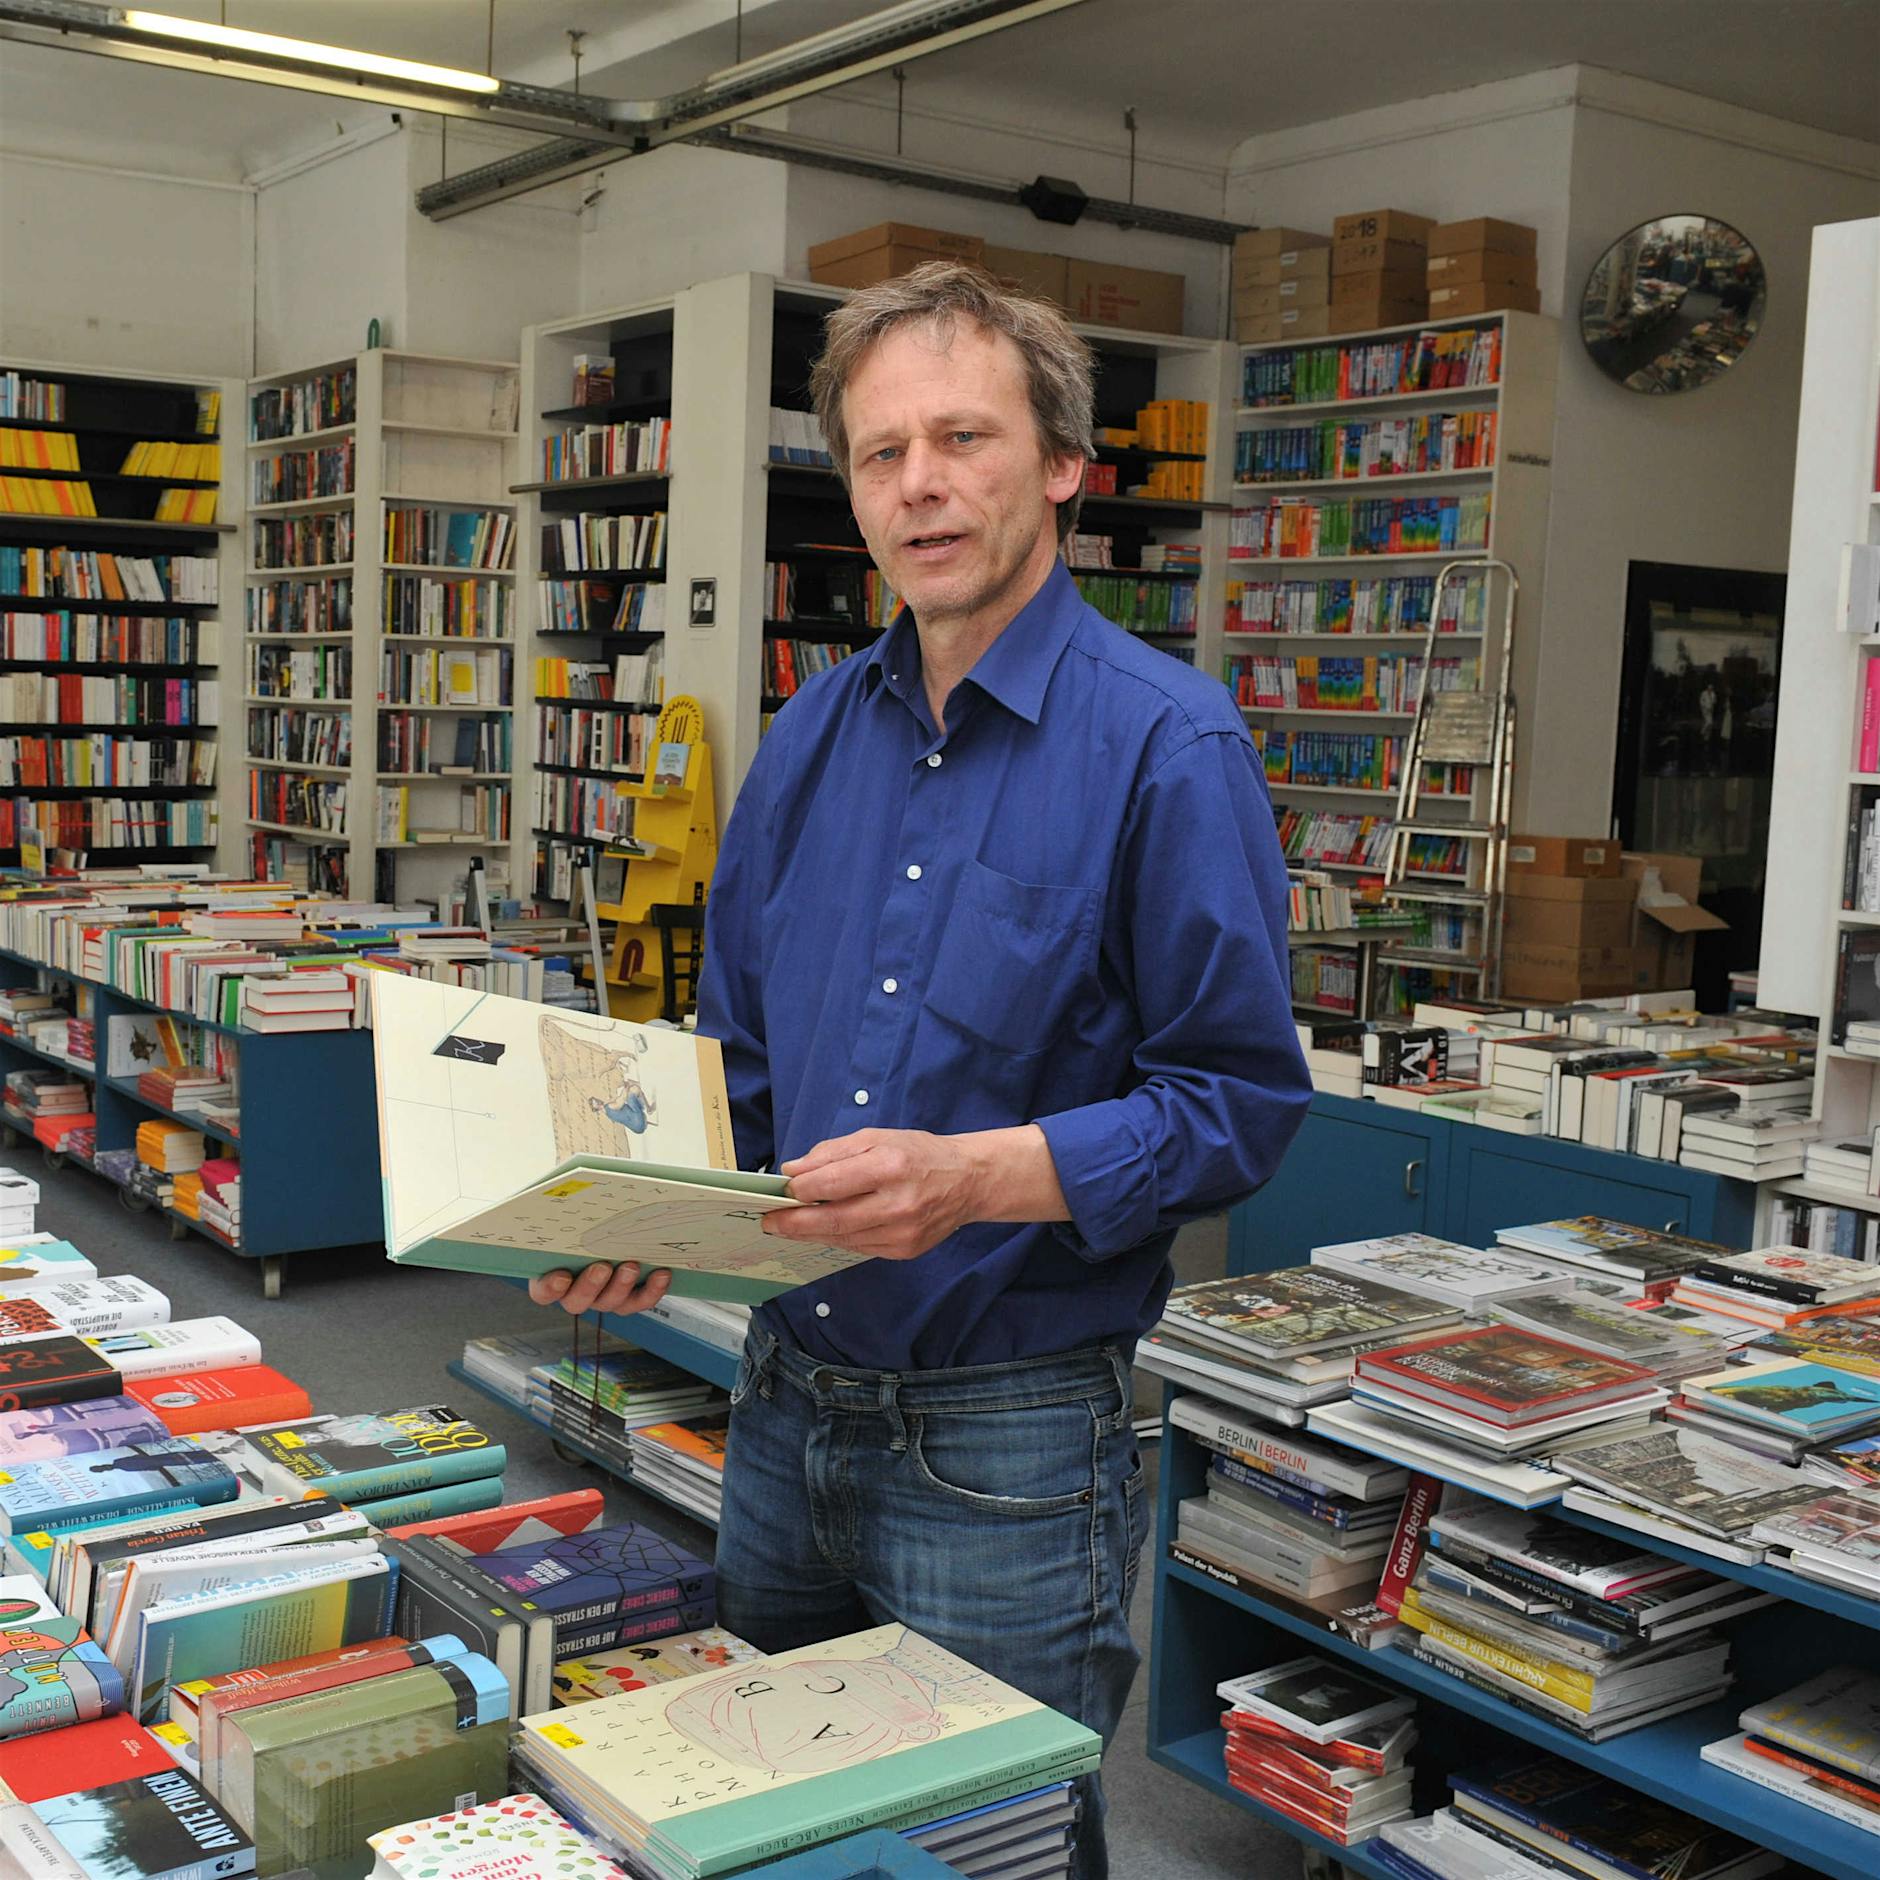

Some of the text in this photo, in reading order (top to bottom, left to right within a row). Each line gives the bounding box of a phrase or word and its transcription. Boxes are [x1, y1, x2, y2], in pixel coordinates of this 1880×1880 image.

[92, 1323, 117, 1334] ROBERT
[1217, 1425, 1259, 1452] BERLIN
[1265, 1443, 1309, 1473] BERLIN
[36, 1496, 196, 1531] ISABEL ALLENDE DIESER WEITE WEG
[127, 1534, 164, 1548] Garcia
[165, 1527, 208, 1541] Tristan
[1393, 1488, 1428, 1579] Ganz Berlin
[151, 1554, 195, 1565] NOVELLE
[1173, 1549, 1239, 1586] Palast der Republik
[586, 1604, 601, 1619] DEN
[602, 1600, 617, 1615] AUF
[586, 1635, 600, 1649] DEN
[602, 1630, 617, 1645] AUF
[1429, 1621, 1468, 1649] BERLIN
[1434, 1658, 1465, 1679] BERLIN
[1469, 1642, 1547, 1687] ARCHITEKTUR
[257, 1678, 302, 1694] Wilhelm
[9, 1694, 71, 1719] BENNETT
[735, 1675, 853, 1741] B C A
[23, 1714, 56, 1729] BRIT
[500, 1820, 536, 1833] INSEL
[827, 1813, 865, 1833] NEUES
[756, 1826, 821, 1855] ABC-BUCH
[455, 1847, 501, 1865] ROMAN
[449, 1853, 534, 1880] Morgen
